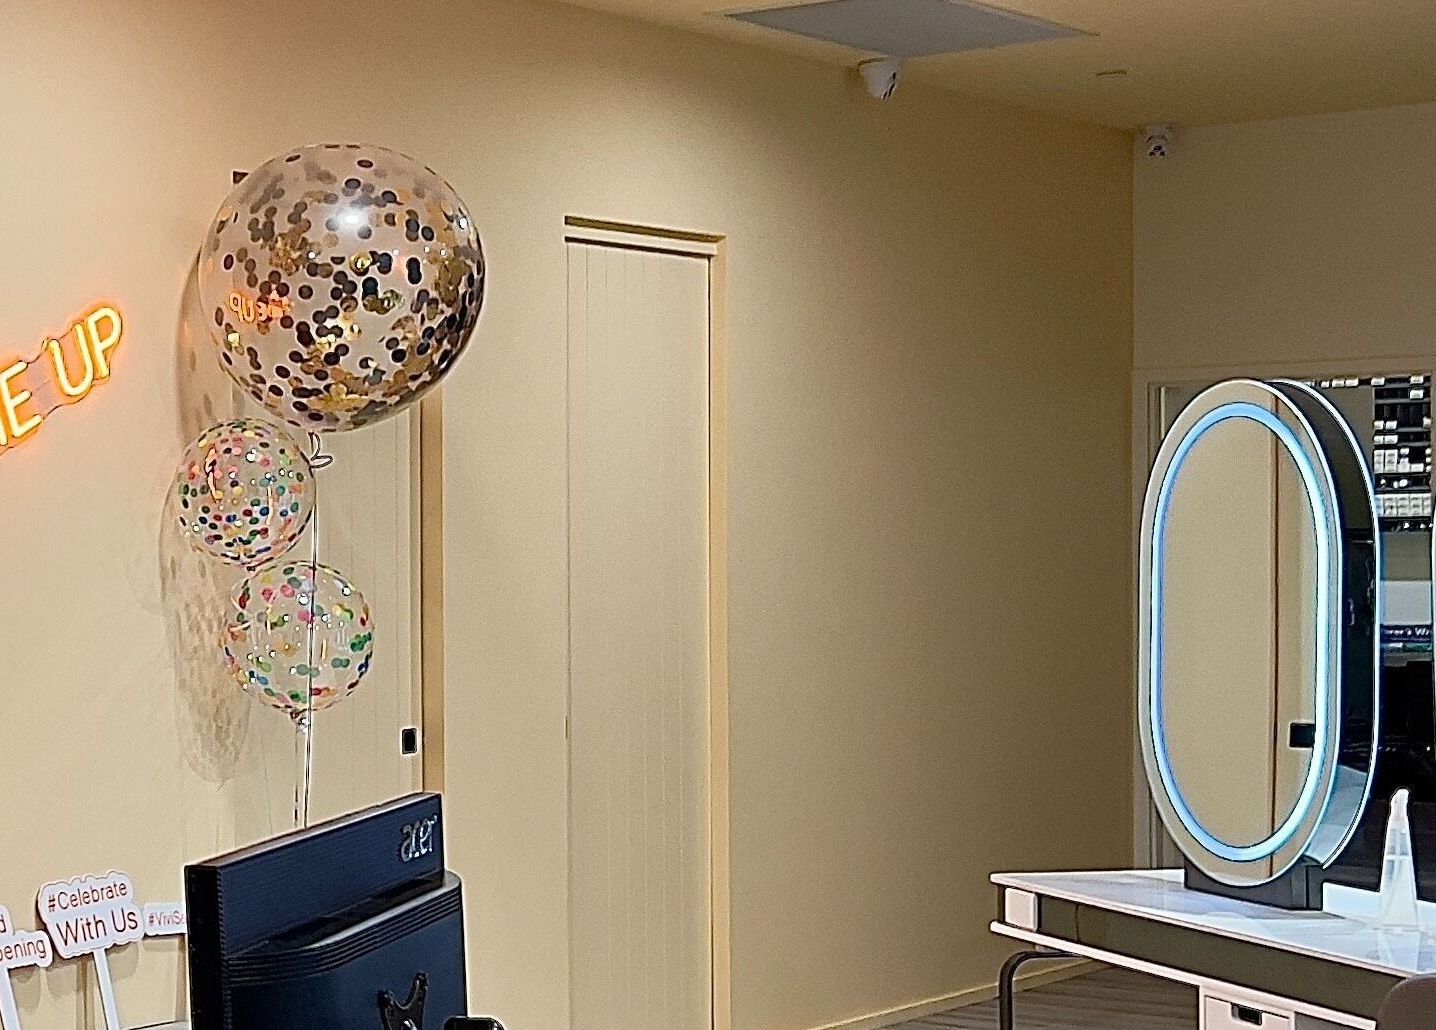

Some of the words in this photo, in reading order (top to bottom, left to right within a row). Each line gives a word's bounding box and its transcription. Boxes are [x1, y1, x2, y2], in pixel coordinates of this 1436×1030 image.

[48, 306, 123, 397] UP
[401, 815, 437, 861] acer
[47, 880, 127, 912] #Celebrate
[56, 912, 107, 946] With
[113, 907, 139, 933] Us
